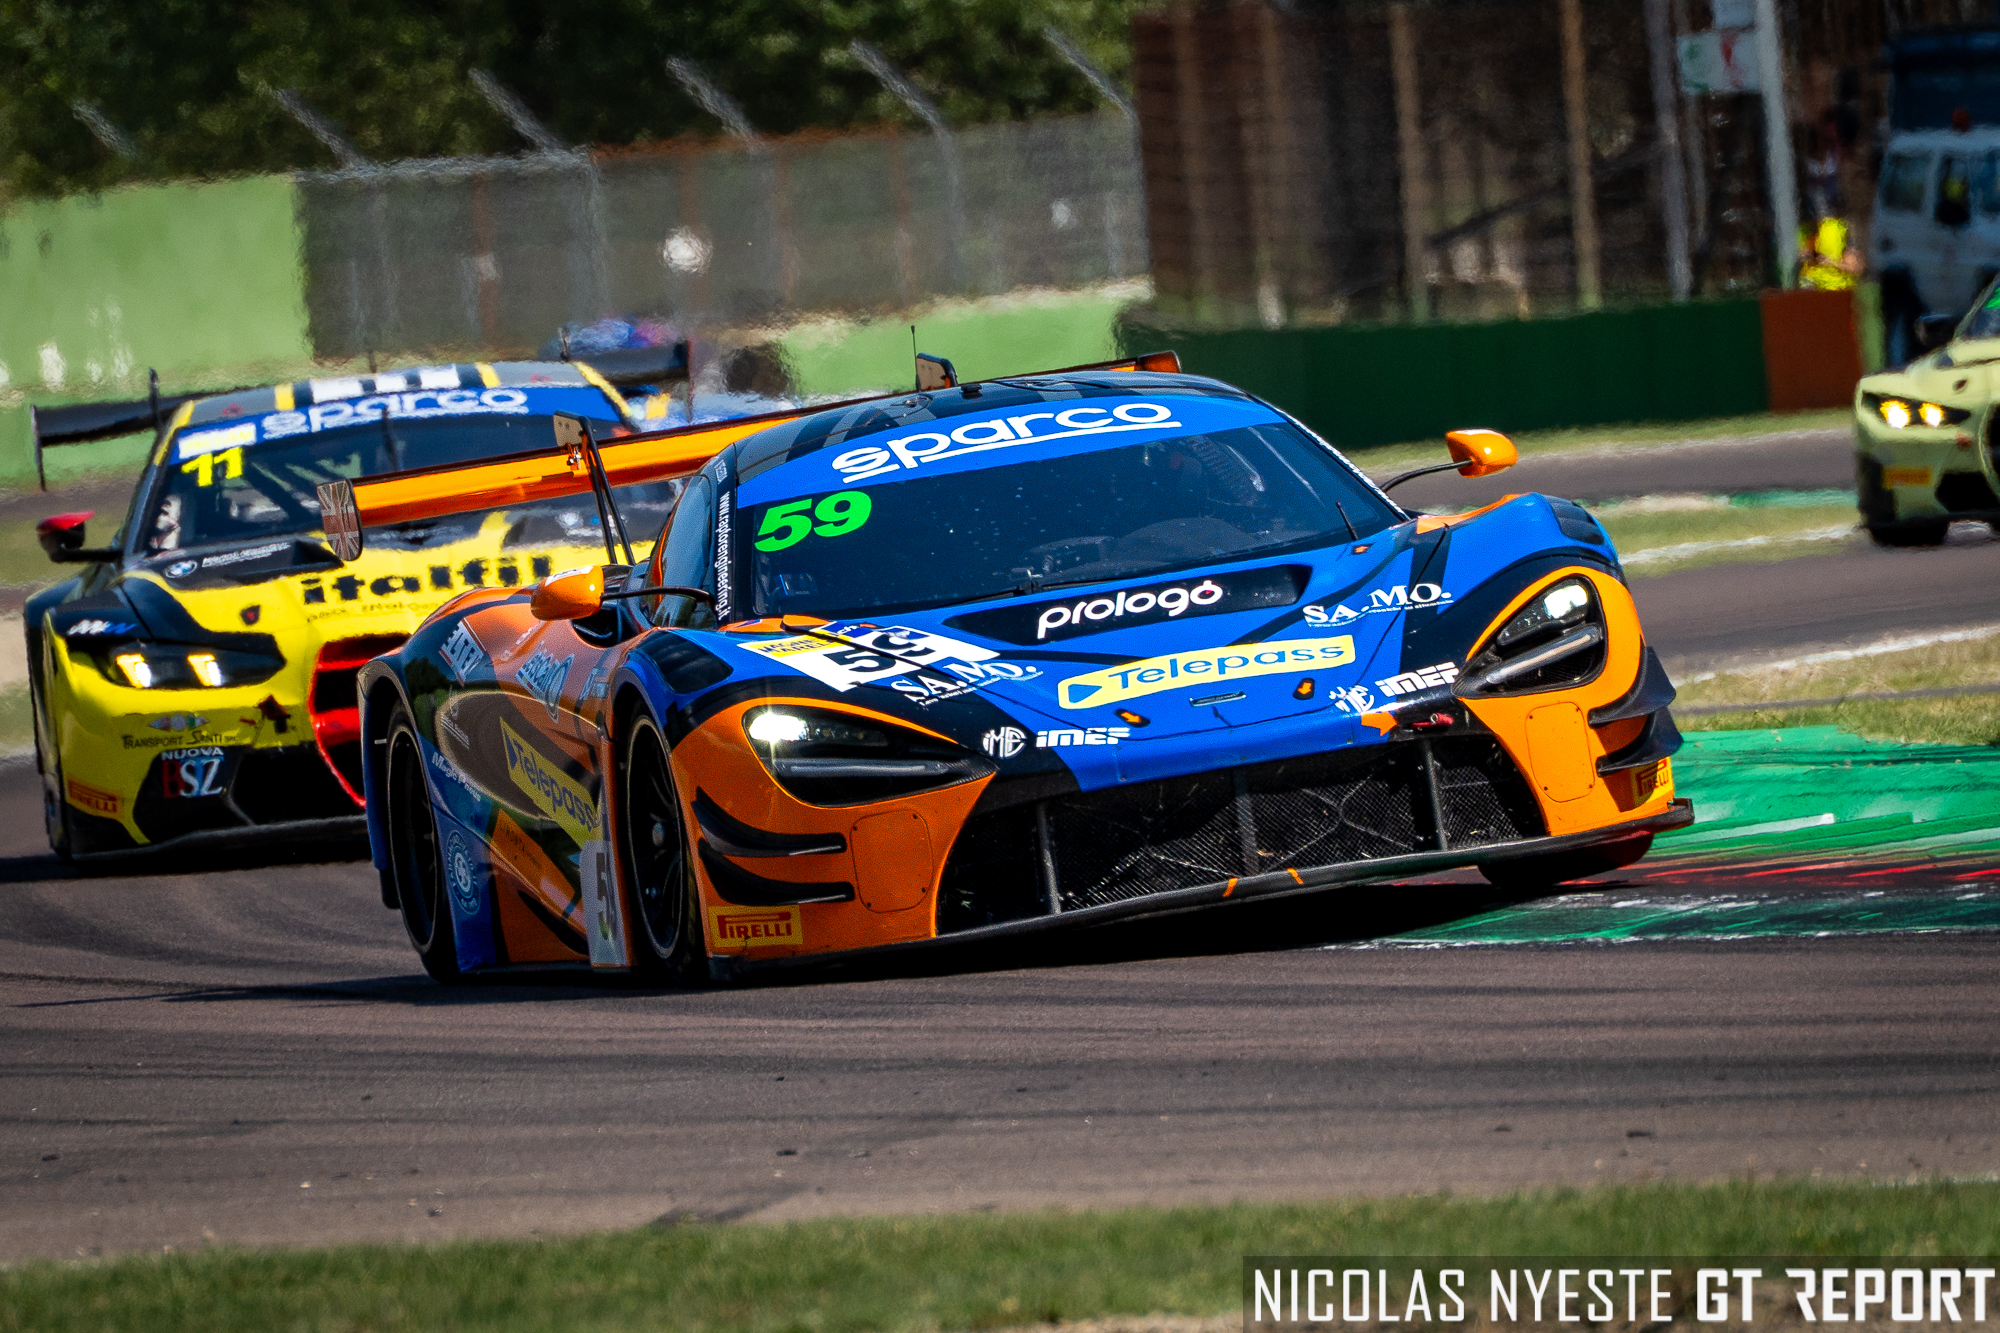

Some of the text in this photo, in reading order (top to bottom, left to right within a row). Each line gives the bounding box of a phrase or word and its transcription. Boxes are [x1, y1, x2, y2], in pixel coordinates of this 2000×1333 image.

[262, 388, 529, 440] sparco
[832, 403, 1182, 469] sparco
[181, 446, 245, 487] 11
[754, 491, 872, 552] 59
[715, 491, 732, 621] www.raptorengineering.it
[1037, 580, 1223, 639] prologo
[1108, 645, 1344, 690] Telepass
[161, 747, 224, 761] NUOVA
[717, 911, 792, 940] PIRELLI
